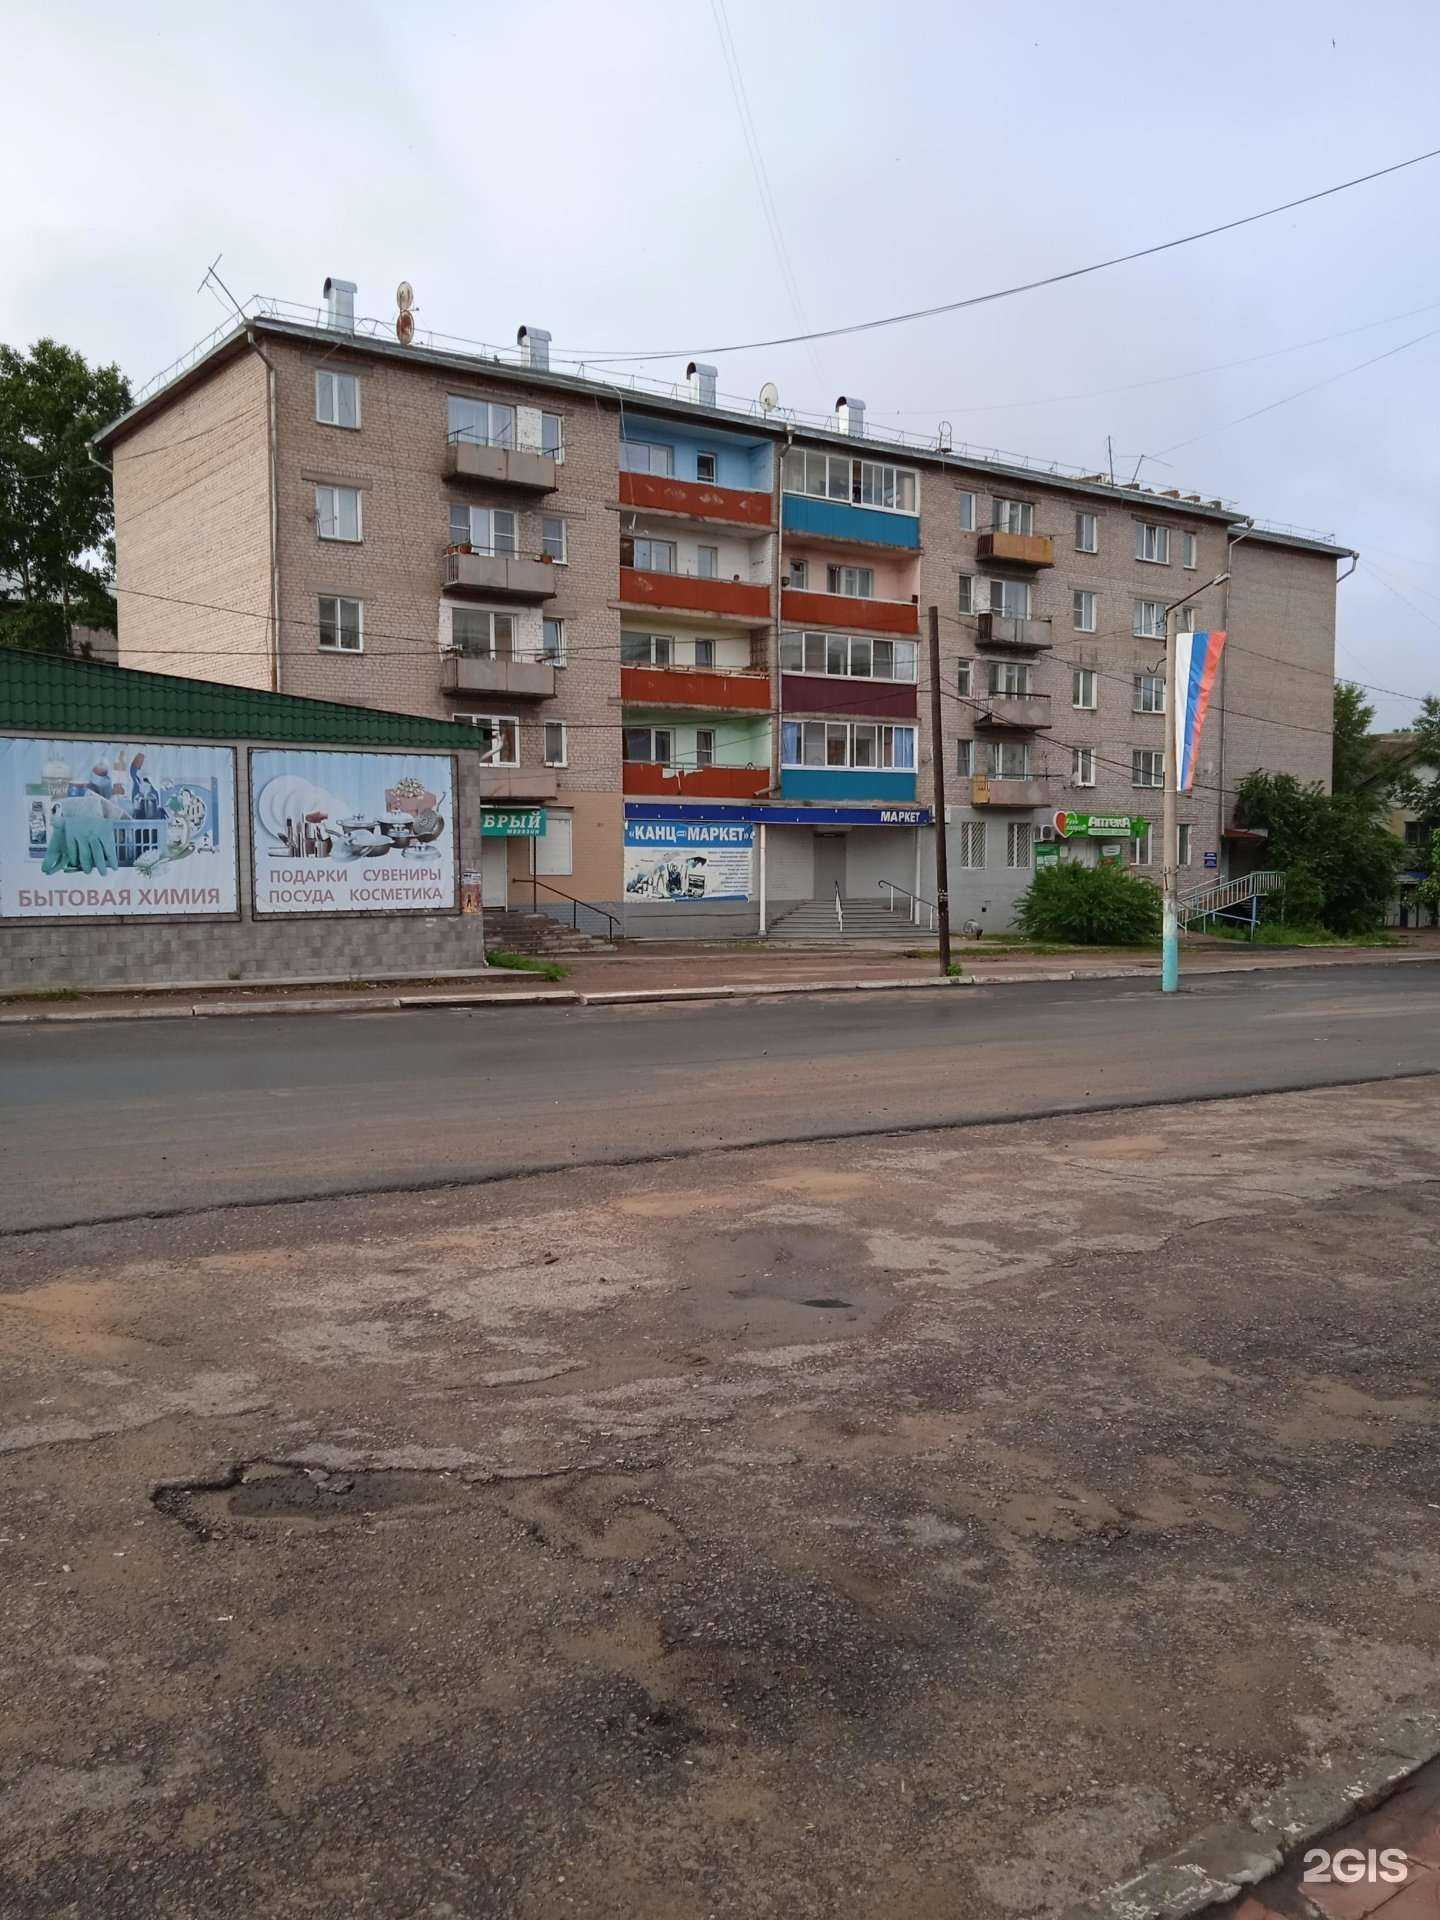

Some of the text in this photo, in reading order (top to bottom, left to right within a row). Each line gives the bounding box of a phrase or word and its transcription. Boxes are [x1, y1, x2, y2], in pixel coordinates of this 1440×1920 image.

[880, 811, 920, 823] МАРКЕТ
[270, 868, 441, 885] ПОДАРКИ СУВЕНИРЫ
[18, 888, 220, 907] БЫТОВАЯ ХИМИЯ
[269, 888, 443, 904] ПОСУДА КОСМЕТИКА
